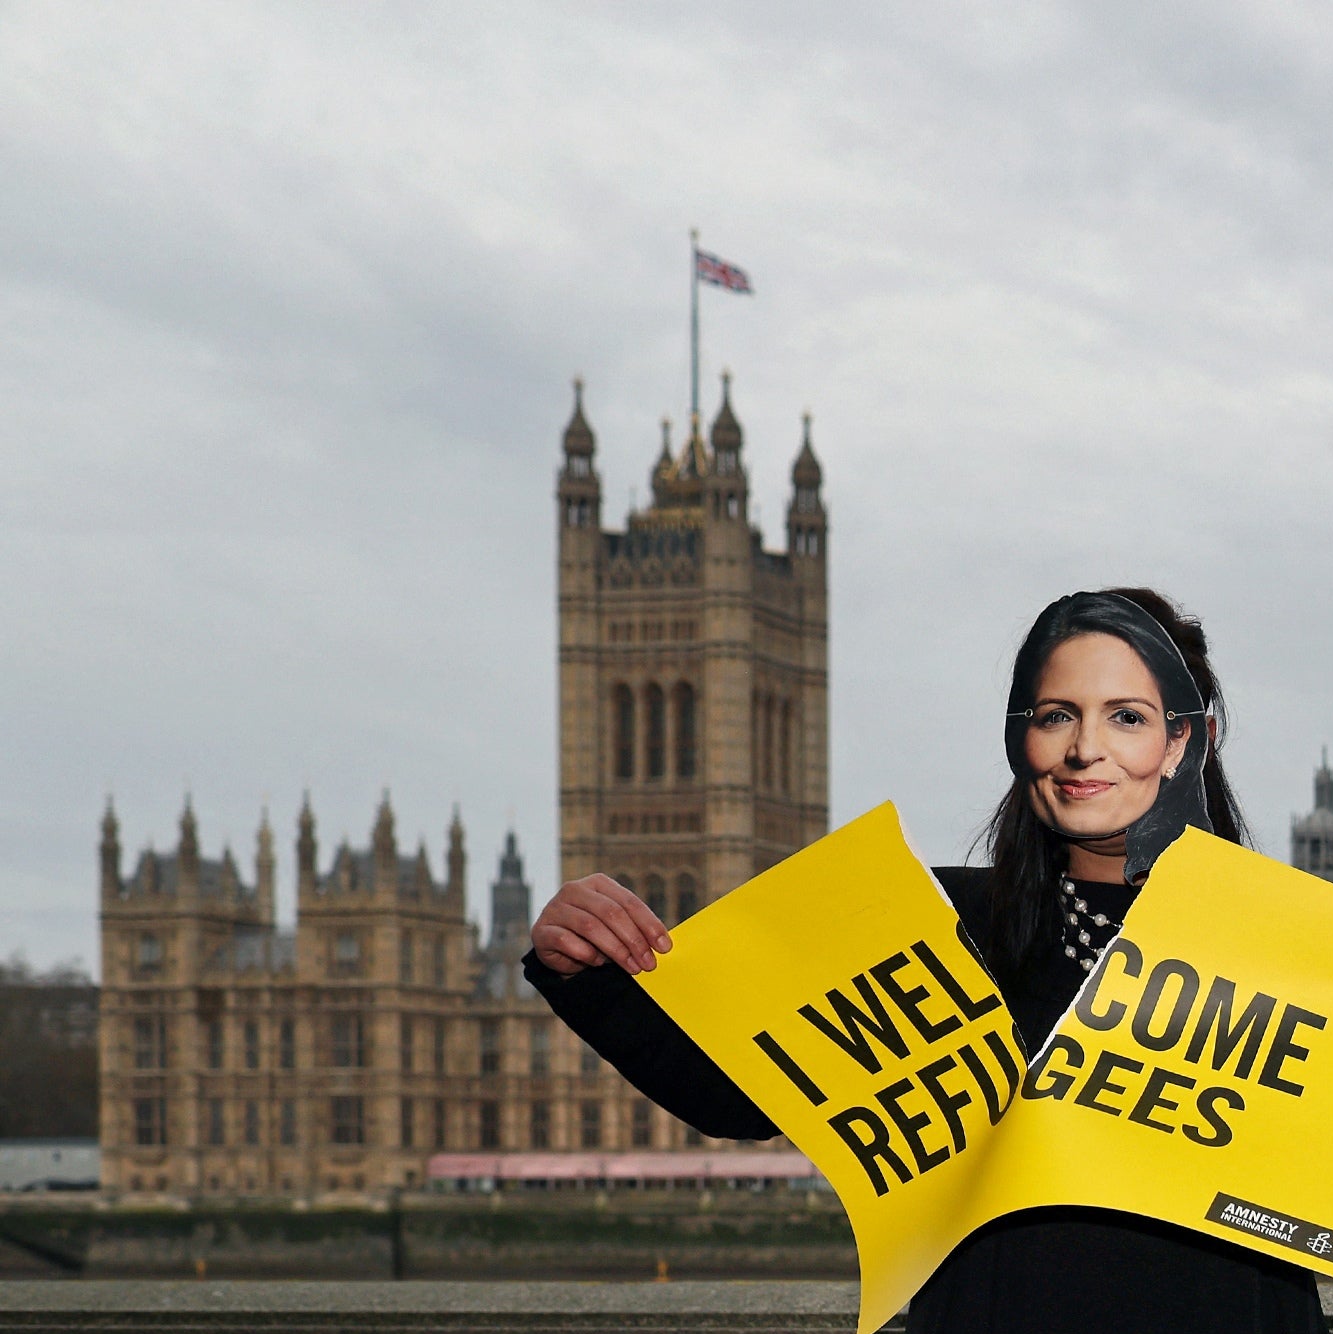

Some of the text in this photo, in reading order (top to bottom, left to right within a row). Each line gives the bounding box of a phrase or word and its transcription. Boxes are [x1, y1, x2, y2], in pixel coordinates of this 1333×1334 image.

[753, 1031, 828, 1106] I
[1220, 1212, 1293, 1243] INTERNATIONAL
[1223, 1202, 1299, 1235] AMNESTY
